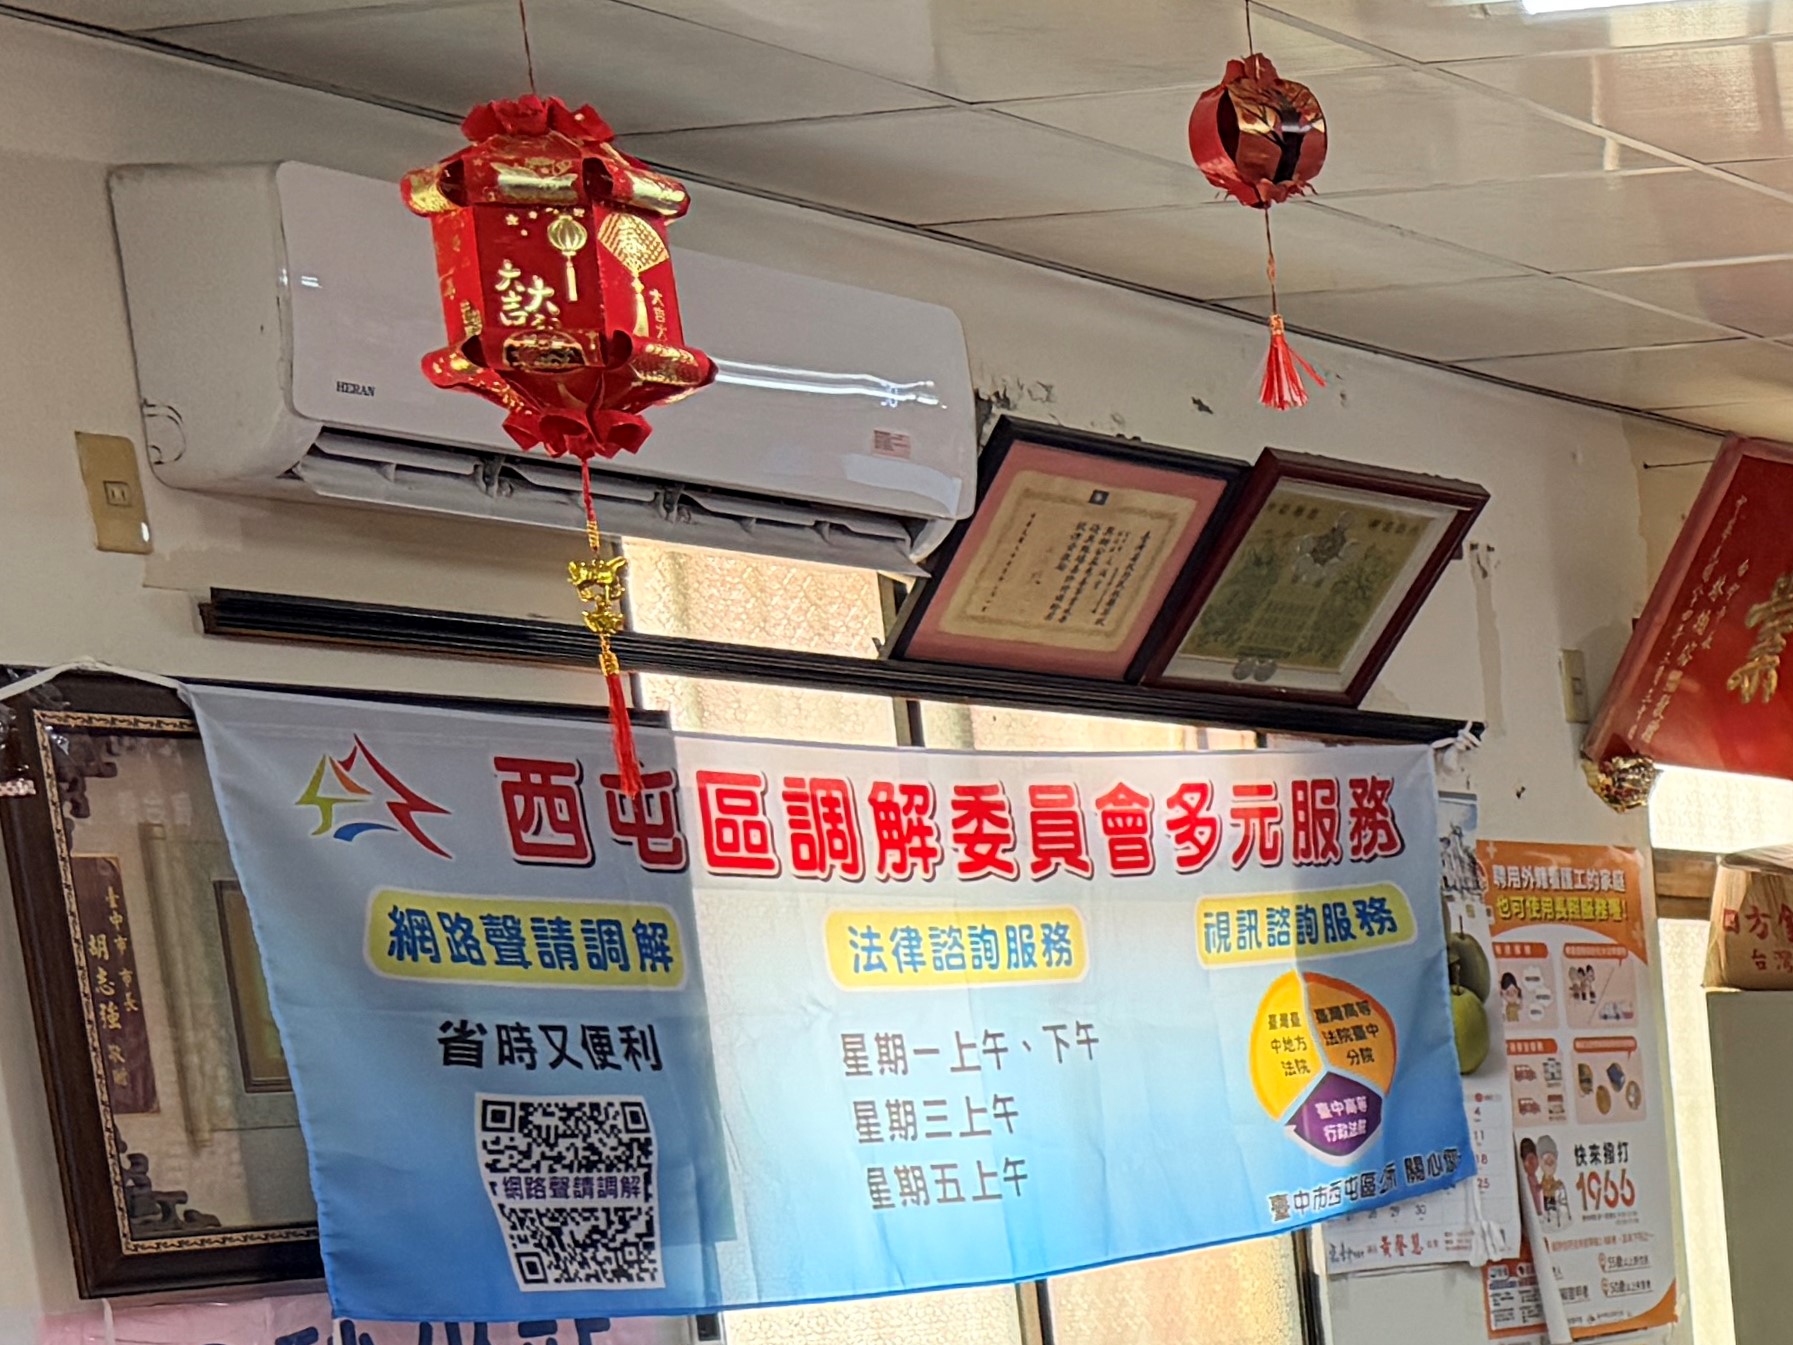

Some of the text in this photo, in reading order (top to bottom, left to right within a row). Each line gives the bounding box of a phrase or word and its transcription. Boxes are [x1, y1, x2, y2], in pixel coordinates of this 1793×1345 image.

[336, 379, 376, 399] HERAN
[493, 755, 1405, 883] 西屯區調解委員會多元服務
[386, 904, 676, 976] 網路聲請調解
[847, 924, 1075, 976] 法律諮詢服務
[1202, 896, 1398, 956] 視訊諮詢服務
[87, 933, 122, 1030] 胡志強
[437, 1019, 664, 1073] 省時又便利
[840, 1019, 1101, 1078] 星期一上午、下午
[1270, 1035, 1308, 1055] 中地方
[1321, 1022, 1380, 1046] 法院臺中
[1346, 1047, 1376, 1066] 分院
[1280, 1058, 1312, 1077] 法院
[852, 1093, 1020, 1147] 星期三上午
[1314, 1095, 1369, 1121] 臺中高等
[501, 1174, 644, 1200] 網路聲請調解
[865, 1156, 1029, 1212] 星期五上午
[1575, 1168, 1636, 1212] 1966
